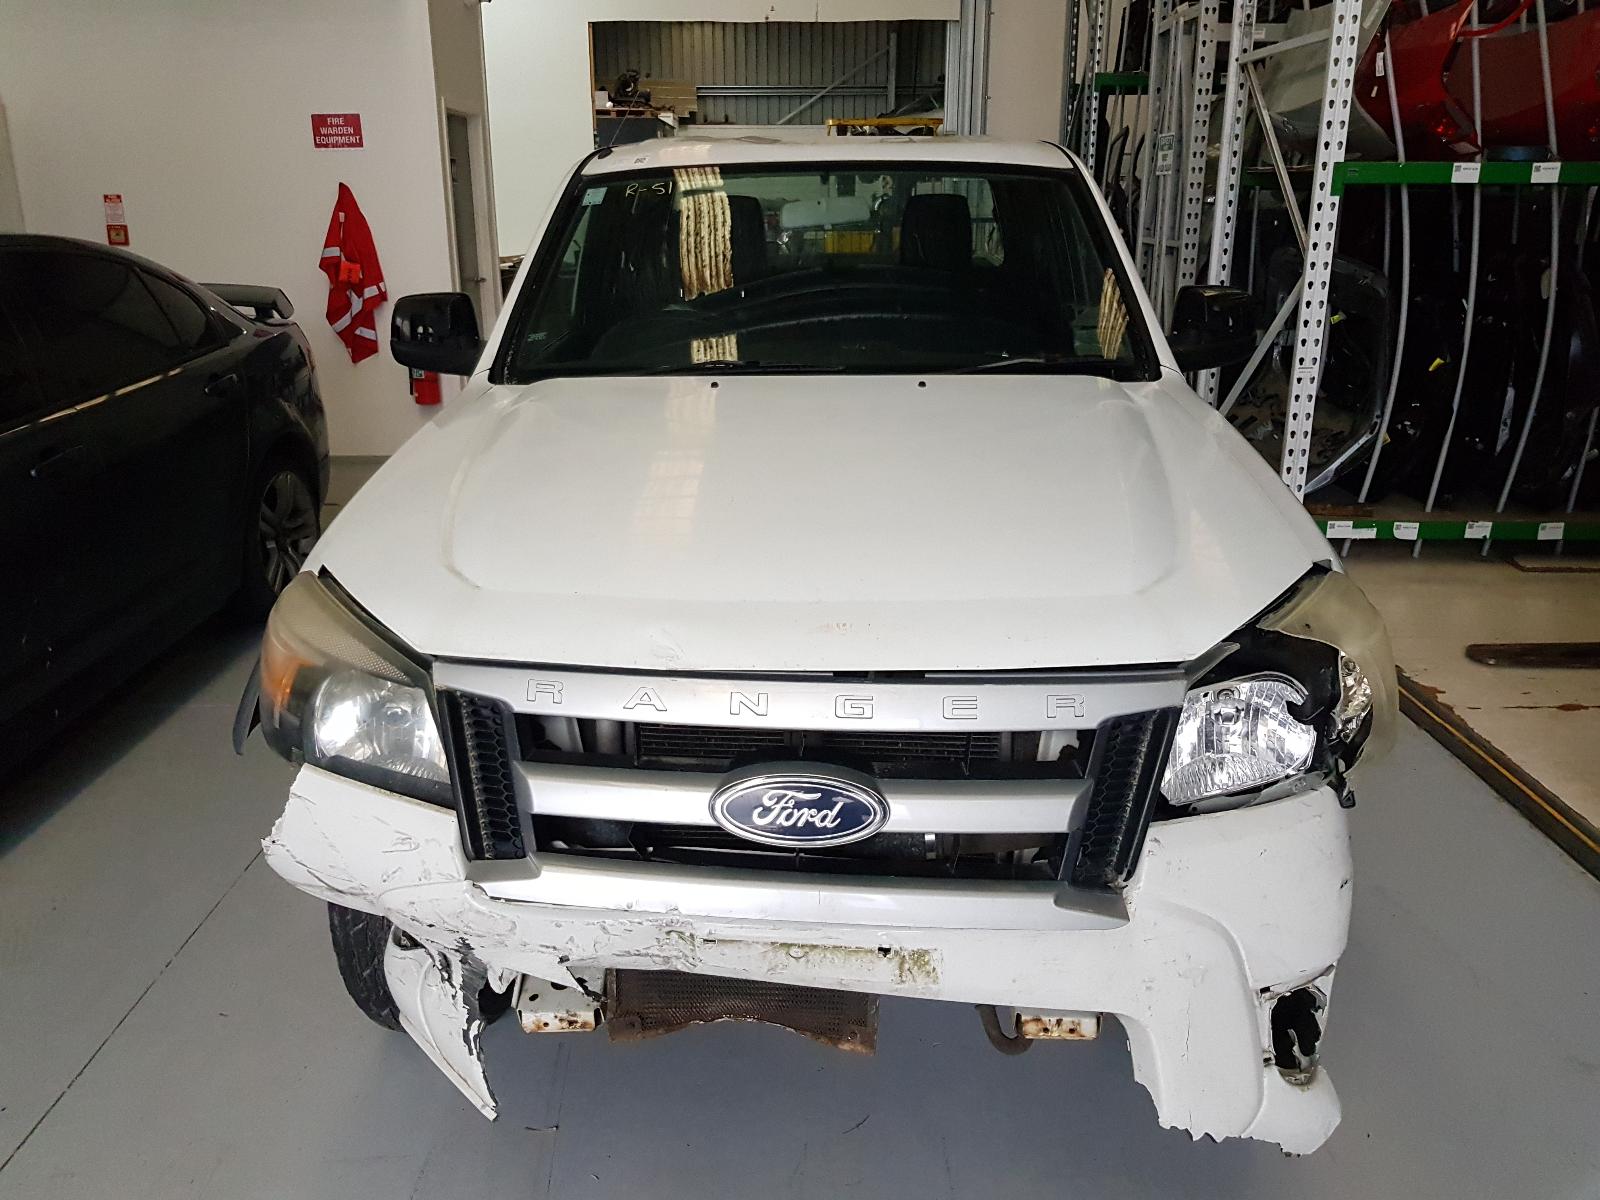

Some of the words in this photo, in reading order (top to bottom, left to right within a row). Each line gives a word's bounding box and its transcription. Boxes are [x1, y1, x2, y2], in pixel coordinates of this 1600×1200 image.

[327, 117, 345, 125] FIRE
[320, 126, 354, 135] WARDEN
[315, 136, 360, 144] EQUIPMENT
[526, 679, 1085, 720] RANGER
[752, 789, 843, 828] Ford
